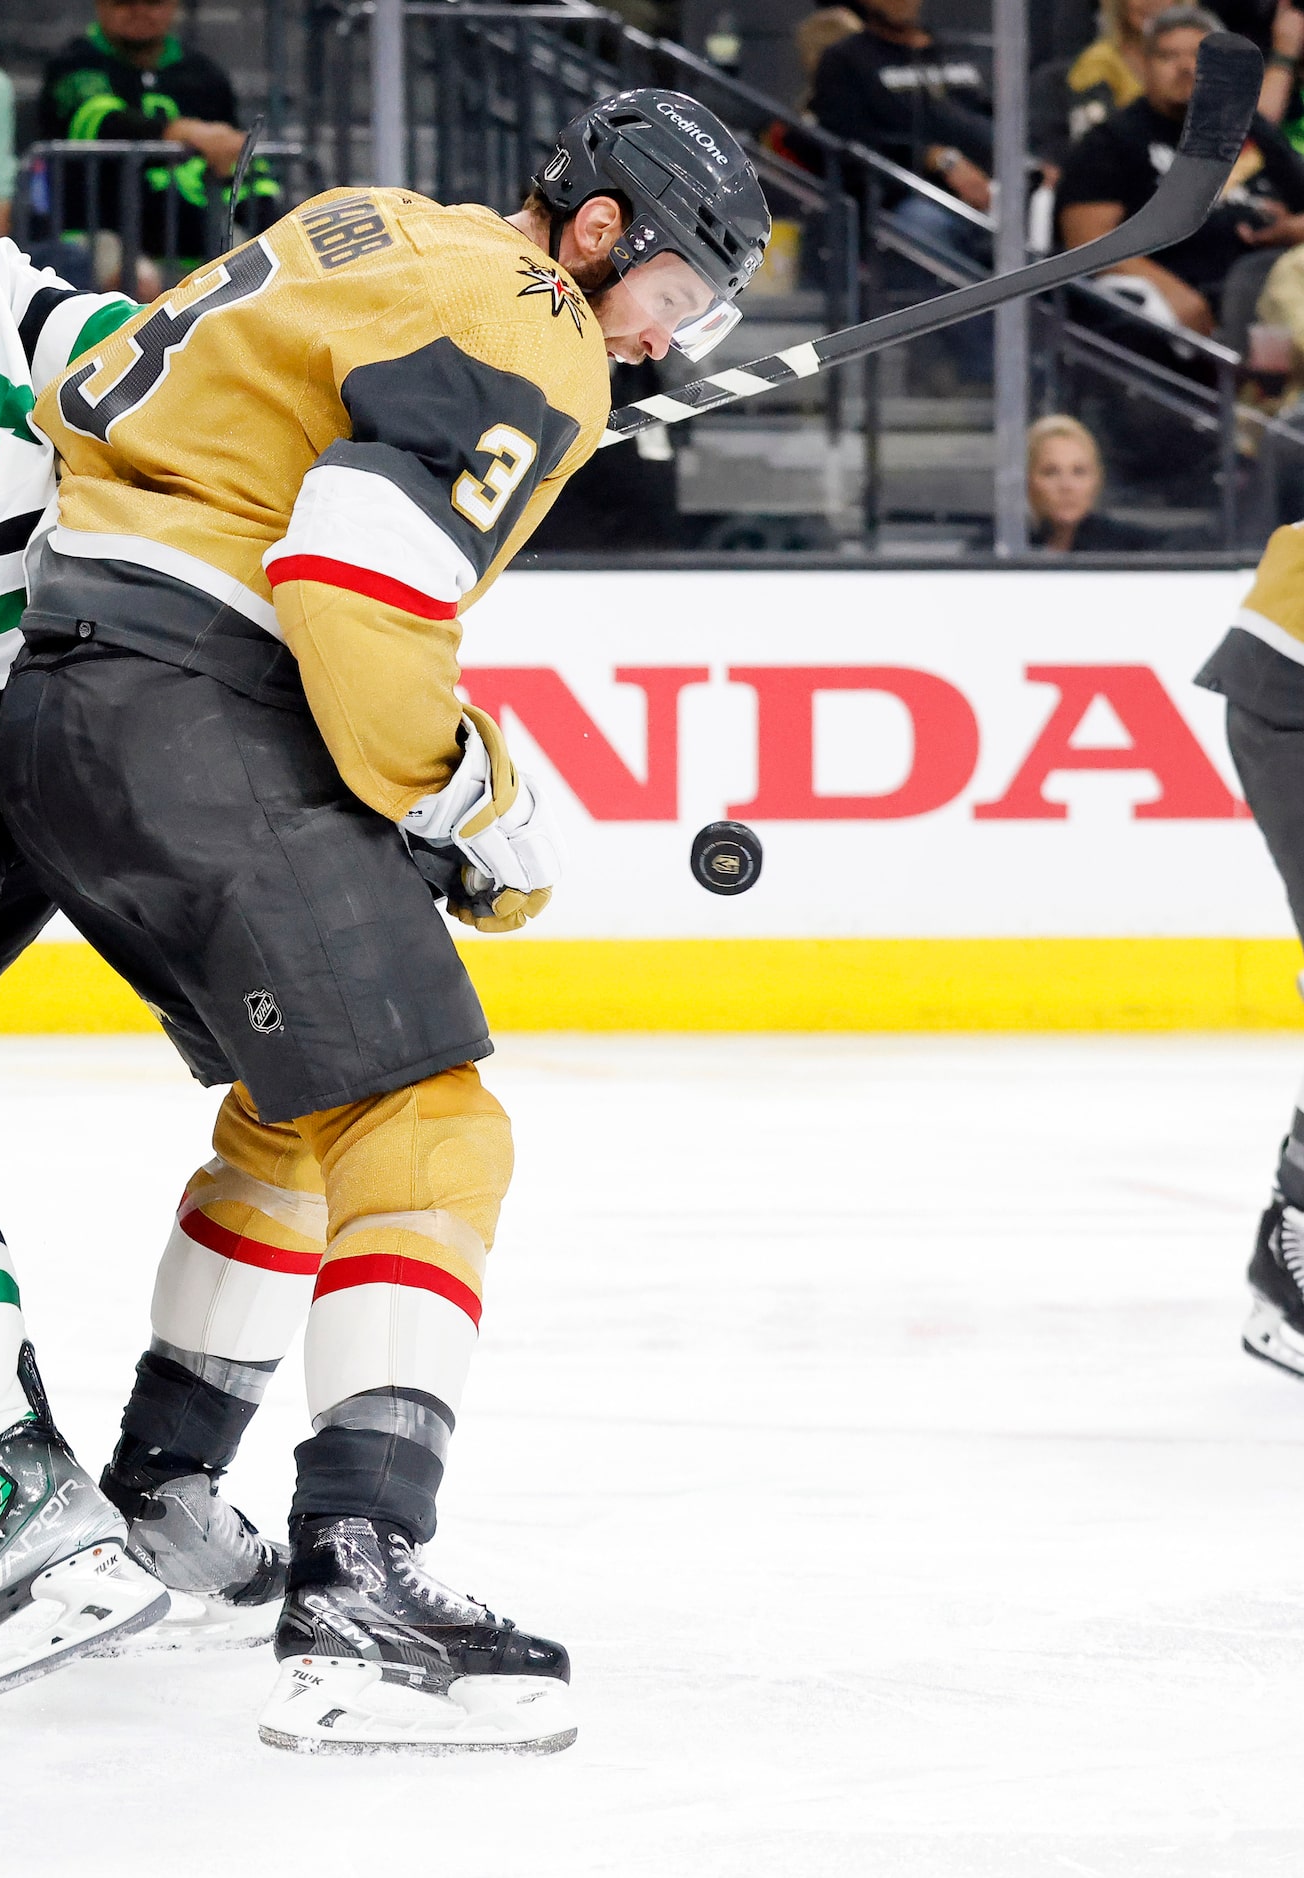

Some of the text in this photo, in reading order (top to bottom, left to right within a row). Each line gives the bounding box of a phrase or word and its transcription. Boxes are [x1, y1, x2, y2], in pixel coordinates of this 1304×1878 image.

[656, 102, 728, 165] CreditOne
[451, 422, 538, 533] 3
[256, 999, 272, 1025] NHL
